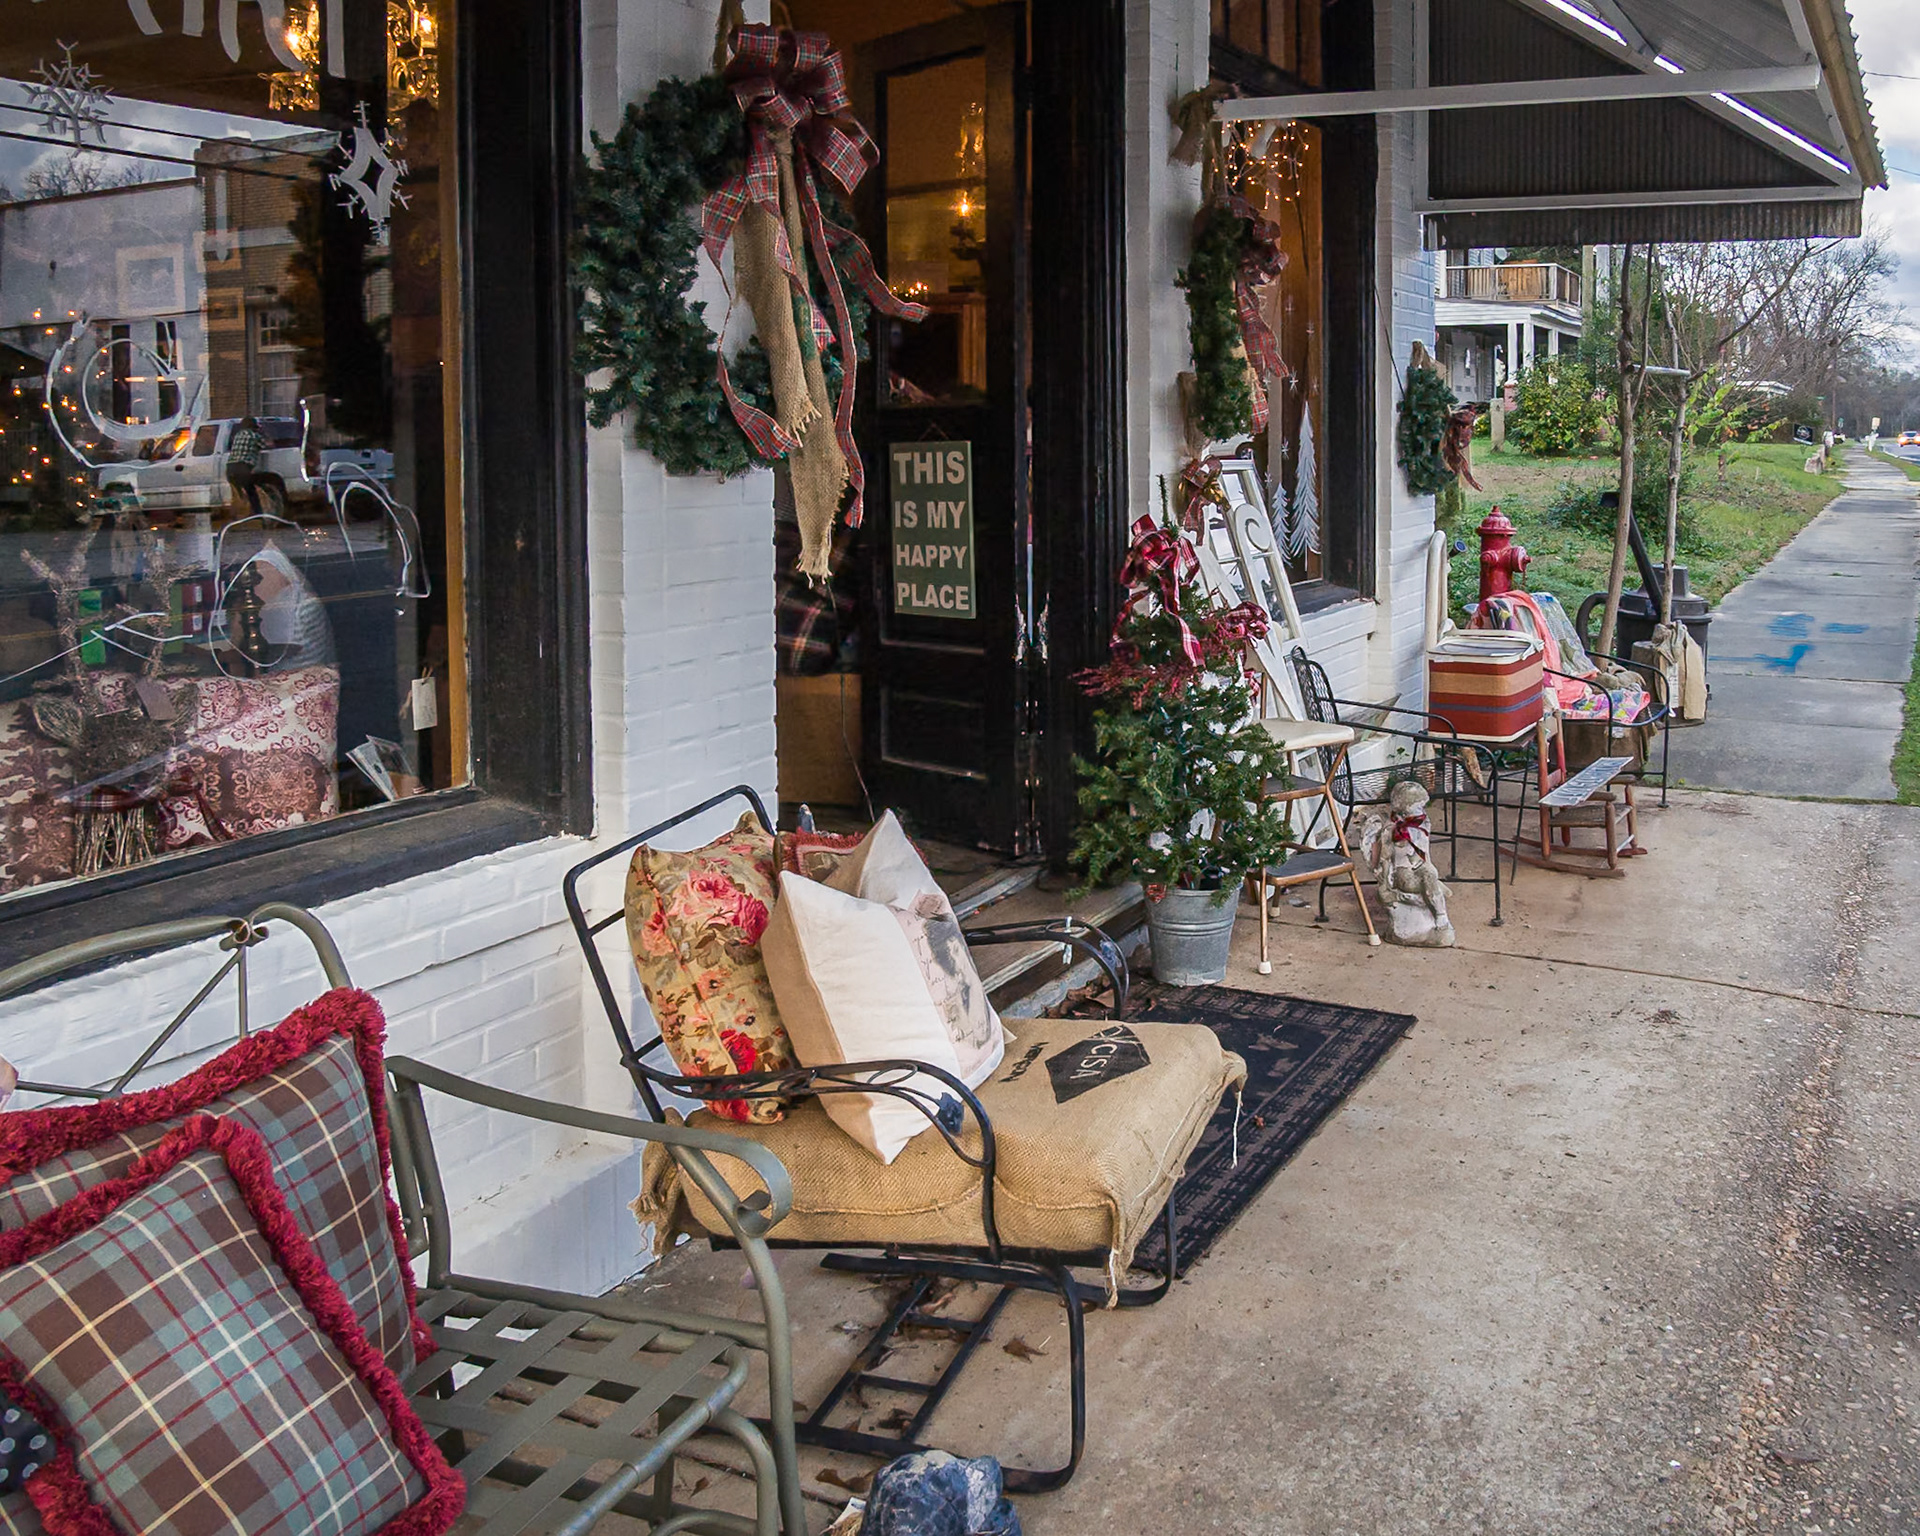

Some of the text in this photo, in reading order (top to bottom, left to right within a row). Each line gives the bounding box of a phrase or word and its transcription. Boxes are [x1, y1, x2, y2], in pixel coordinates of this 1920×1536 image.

[893, 451, 965, 485] THIS
[894, 500, 966, 529] IS MY
[896, 544, 967, 569] HAPPY
[897, 582, 970, 610] PLACE
